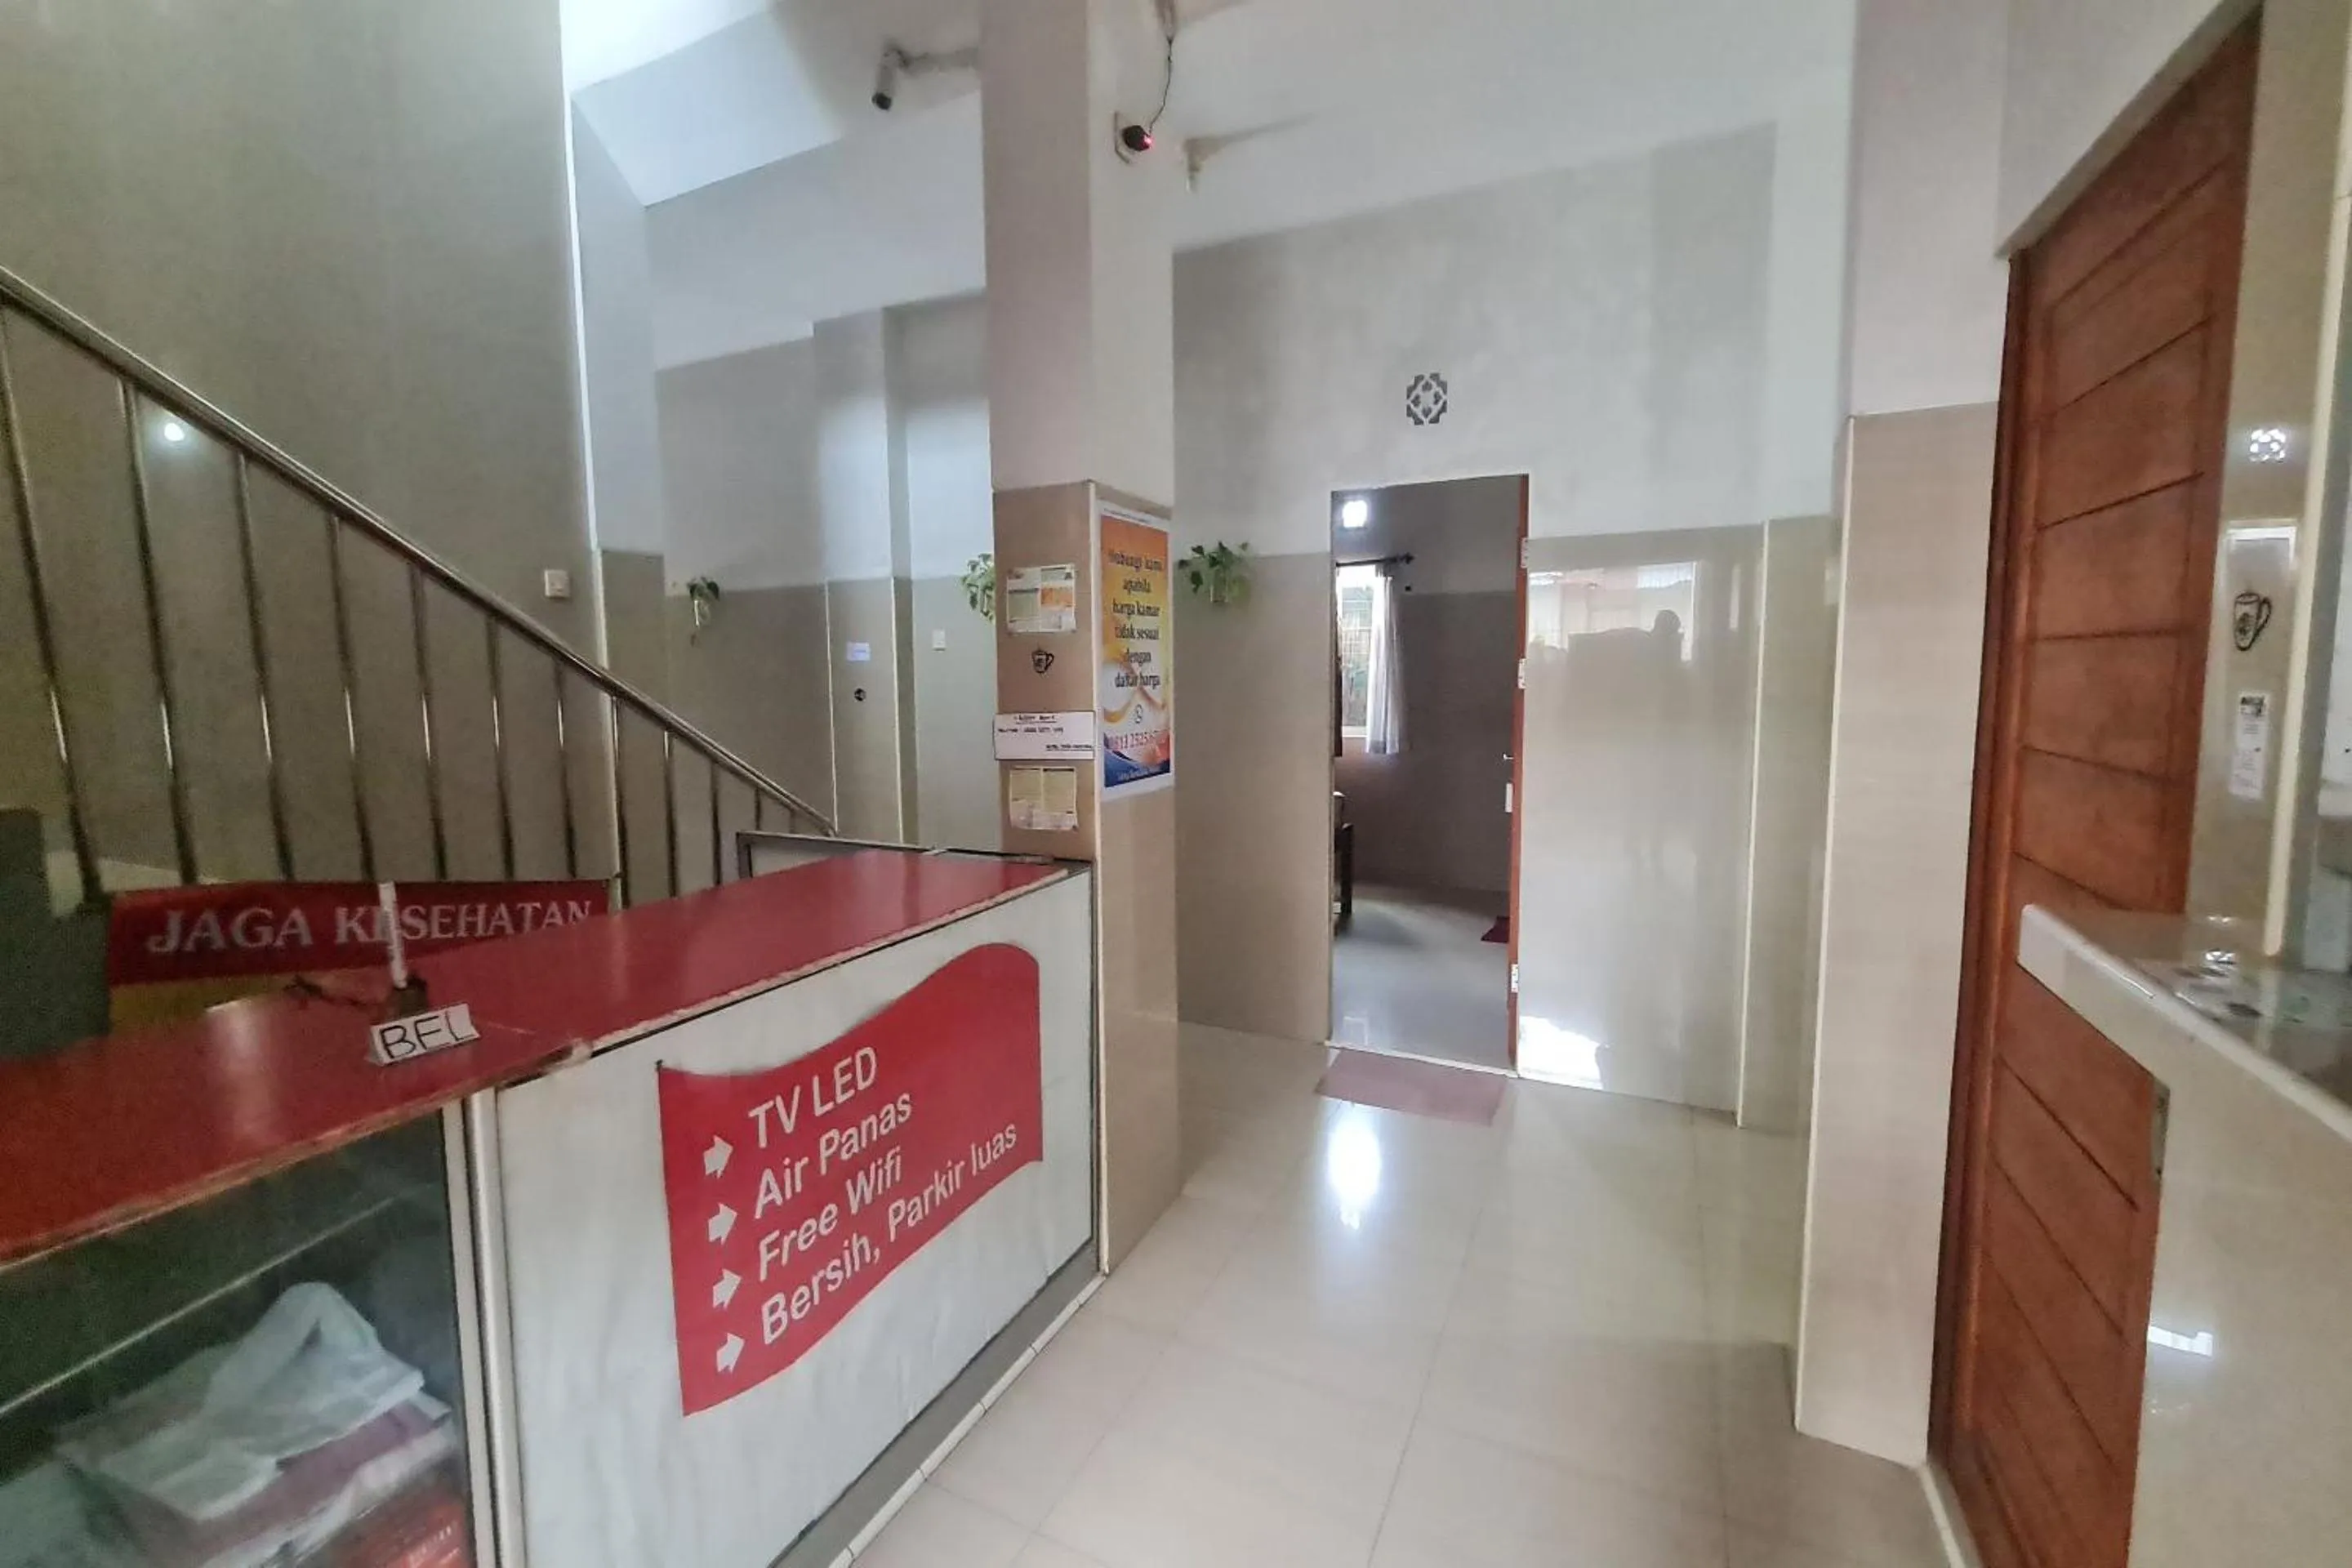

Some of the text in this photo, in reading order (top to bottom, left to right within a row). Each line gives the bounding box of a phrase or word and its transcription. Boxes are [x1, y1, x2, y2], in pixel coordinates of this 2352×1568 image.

[145, 906, 314, 954] JAGA
[748, 1046, 877, 1149] TV LED
[755, 1092, 912, 1219] Air Panas
[759, 1145, 902, 1282] Free Wifi
[761, 1123, 1018, 1345] Bersih, Parkir luas
